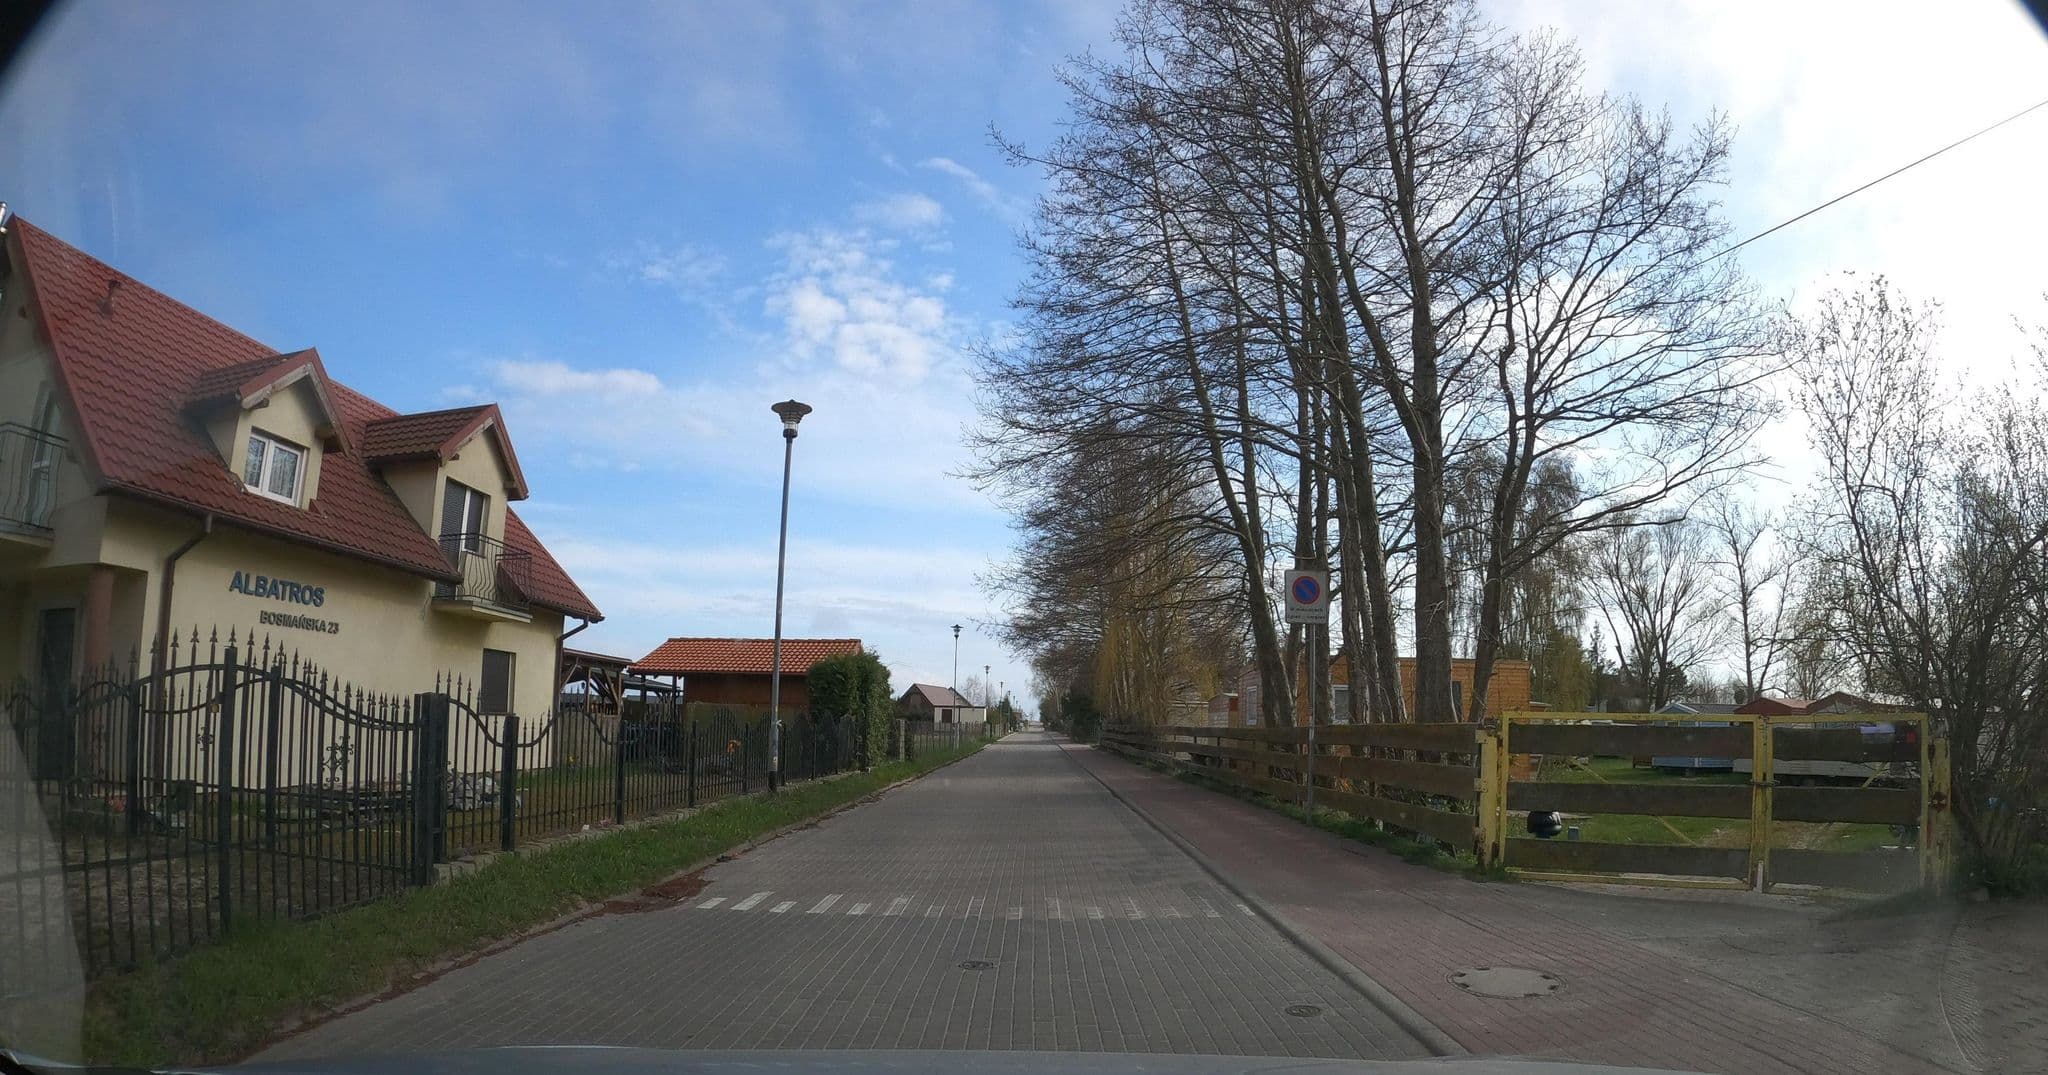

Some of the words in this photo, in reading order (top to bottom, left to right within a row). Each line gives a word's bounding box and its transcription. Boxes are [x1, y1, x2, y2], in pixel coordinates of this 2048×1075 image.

[229, 570, 325, 607] ALBATROS
[260, 610, 326, 633] BOSMAŃSKA
[327, 621, 340, 635] 23
